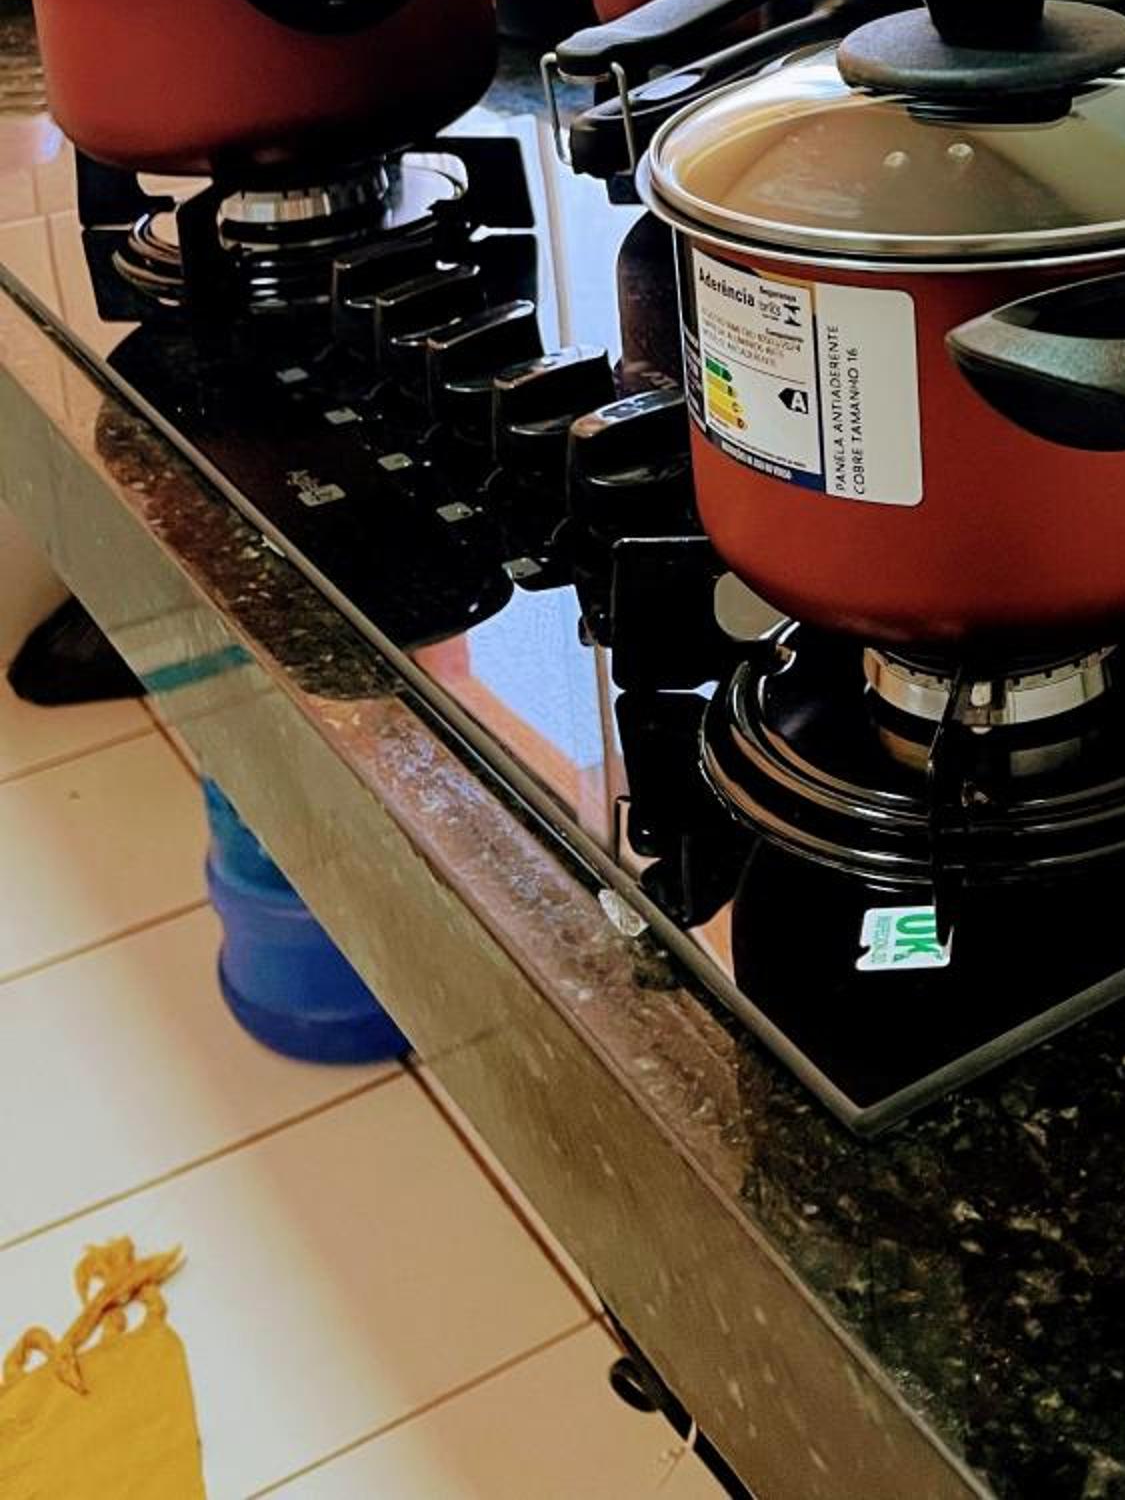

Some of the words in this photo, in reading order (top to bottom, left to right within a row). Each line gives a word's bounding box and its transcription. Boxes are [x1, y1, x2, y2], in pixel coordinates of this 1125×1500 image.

[790, 390, 807, 413] A
[827, 325, 844, 433] ANTIADERENTE
[848, 368, 863, 443] TAMANHO
[833, 437, 847, 491] PANELA
[851, 448, 865, 495] COBRE
